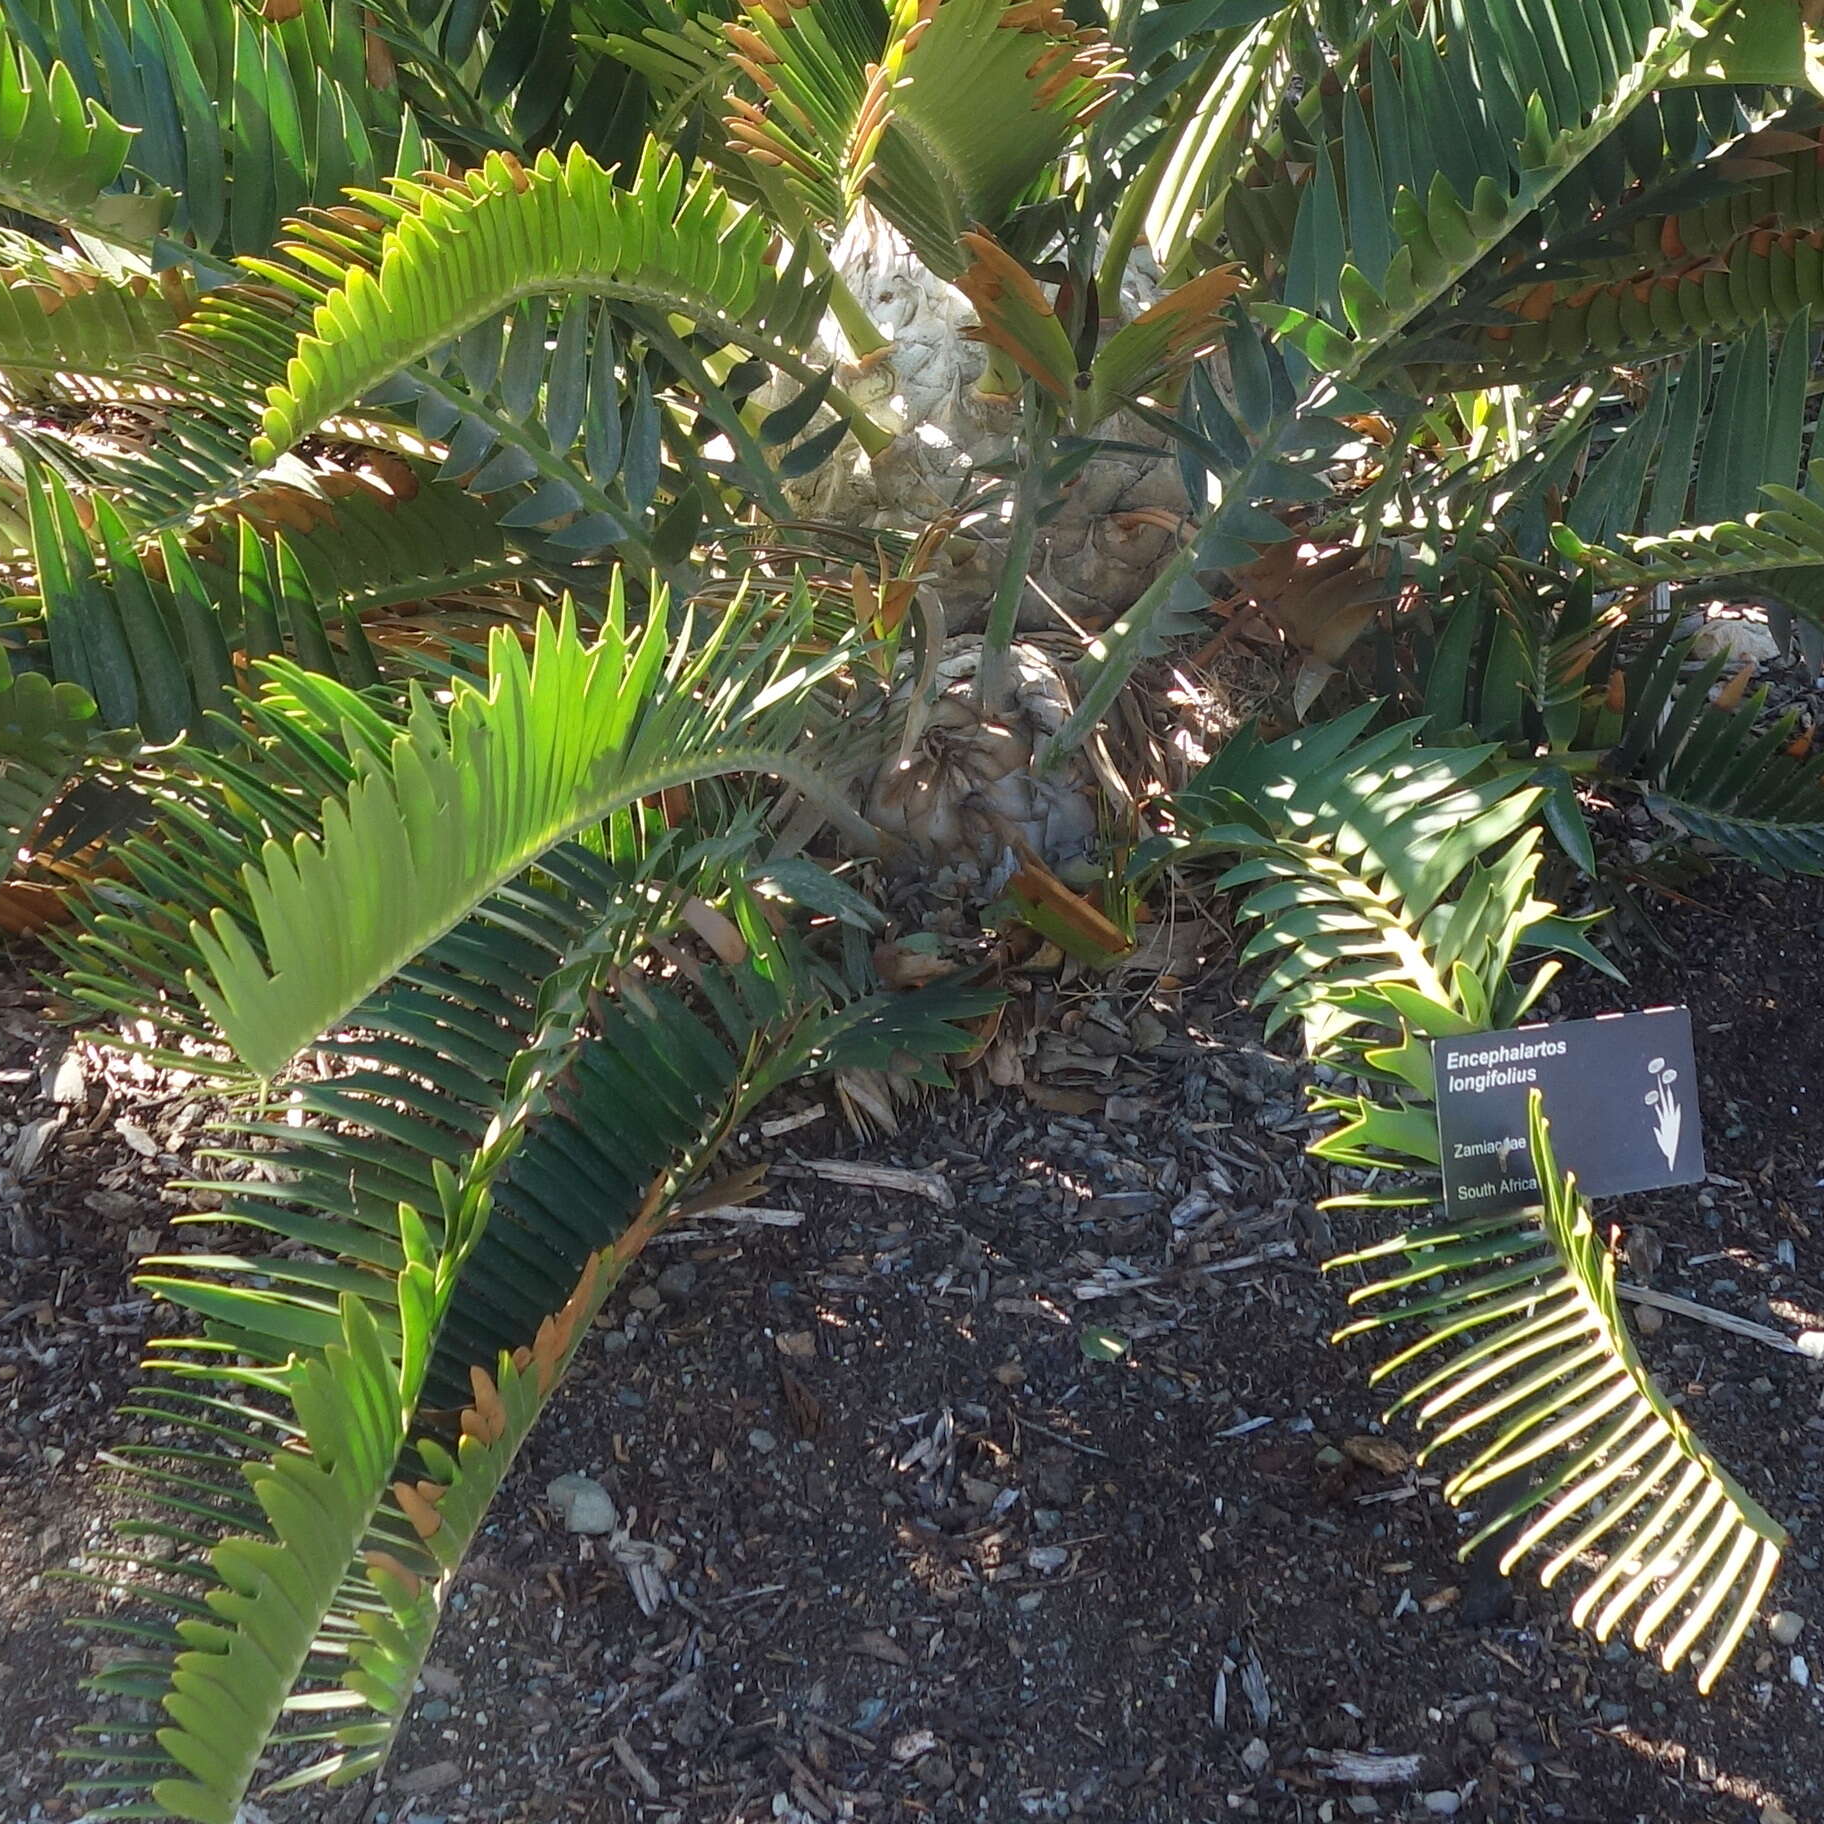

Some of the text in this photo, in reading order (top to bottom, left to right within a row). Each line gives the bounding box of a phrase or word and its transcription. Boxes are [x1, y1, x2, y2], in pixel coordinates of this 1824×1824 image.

[1447, 1040, 1567, 1070] Encephalartos
[1449, 1067, 1537, 1093] longifolius
[1454, 1137, 1527, 1159] Zamiacae
[1458, 1177, 1537, 1201] South Africa
